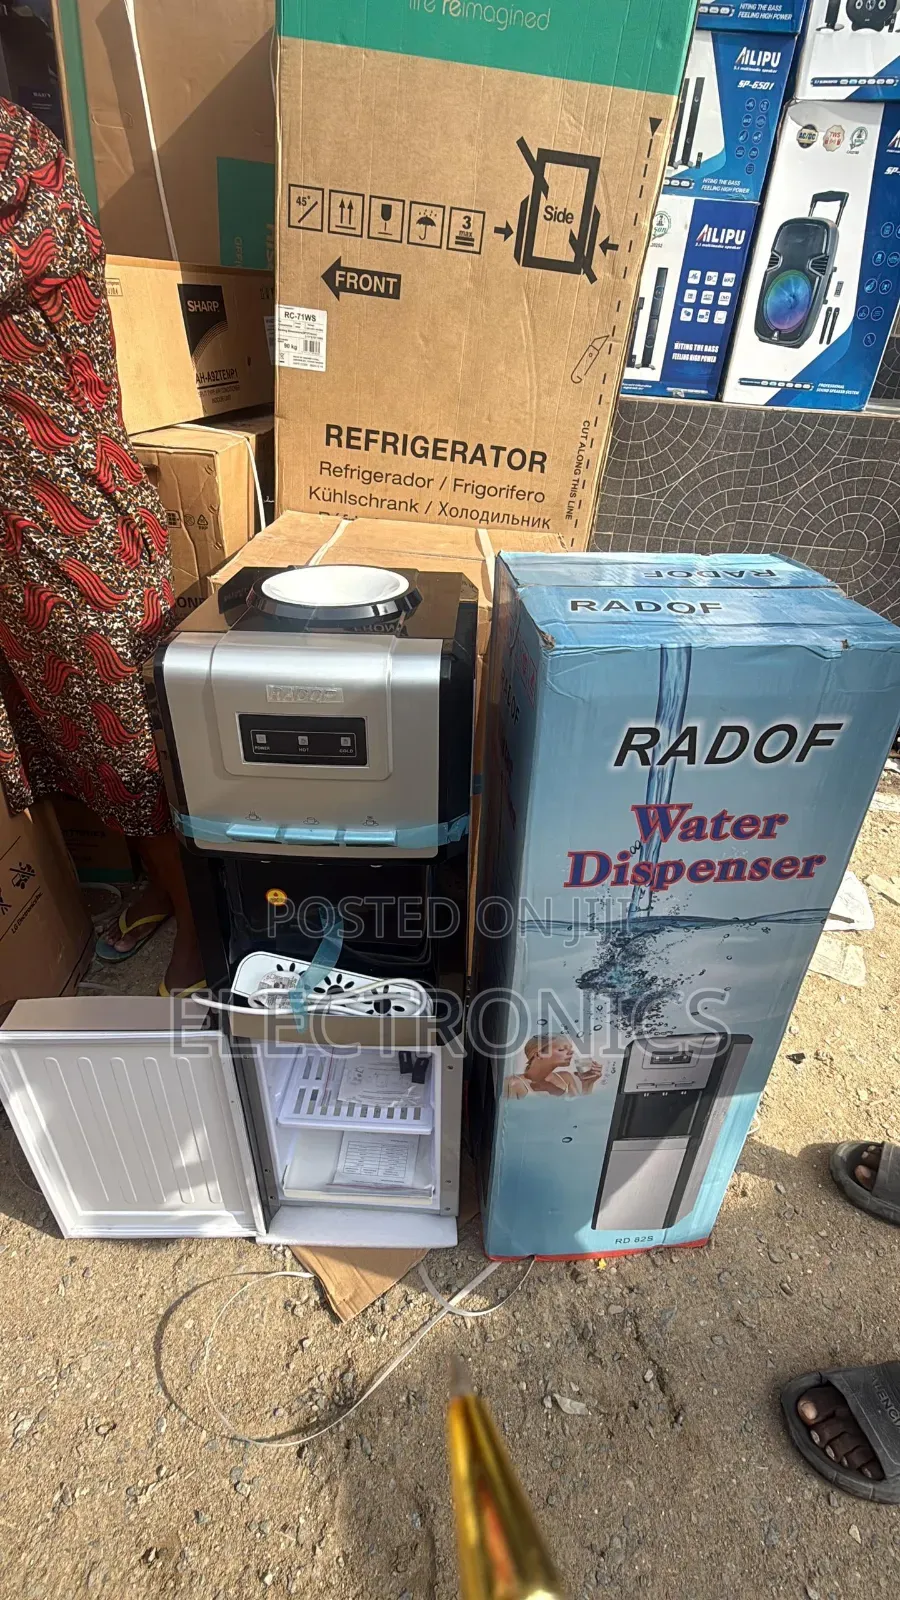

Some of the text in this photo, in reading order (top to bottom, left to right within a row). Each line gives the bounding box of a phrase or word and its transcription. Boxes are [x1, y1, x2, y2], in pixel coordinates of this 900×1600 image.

[442, 0, 551, 31] reimagined
[738, 80, 774, 90] SP-6501
[884, 166, 900, 175] SP-
[462, 216, 472, 230] 3
[542, 204, 574, 225] Side
[458, 230, 472, 238] max
[335, 270, 398, 294] FRONT
[187, 300, 219, 312] SHARP
[284, 311, 316, 322] RC-71WS
[325, 424, 548, 474] REFRIGERATOR
[565, 420, 590, 520] CUT ALONG THIS LINE
[320, 461, 545, 504] Refrigerador / Frigorifero
[309, 485, 551, 530] Kühlschrank / Холодильник
[644, 568, 776, 579] RADOF
[570, 599, 723, 615] RADOF
[613, 722, 844, 767] RADOF
[630, 802, 789, 844] Water
[563, 849, 826, 892] Dispenser
[10, 924, 19, 934] LG
[634, 1235, 654, 1244] 82S
